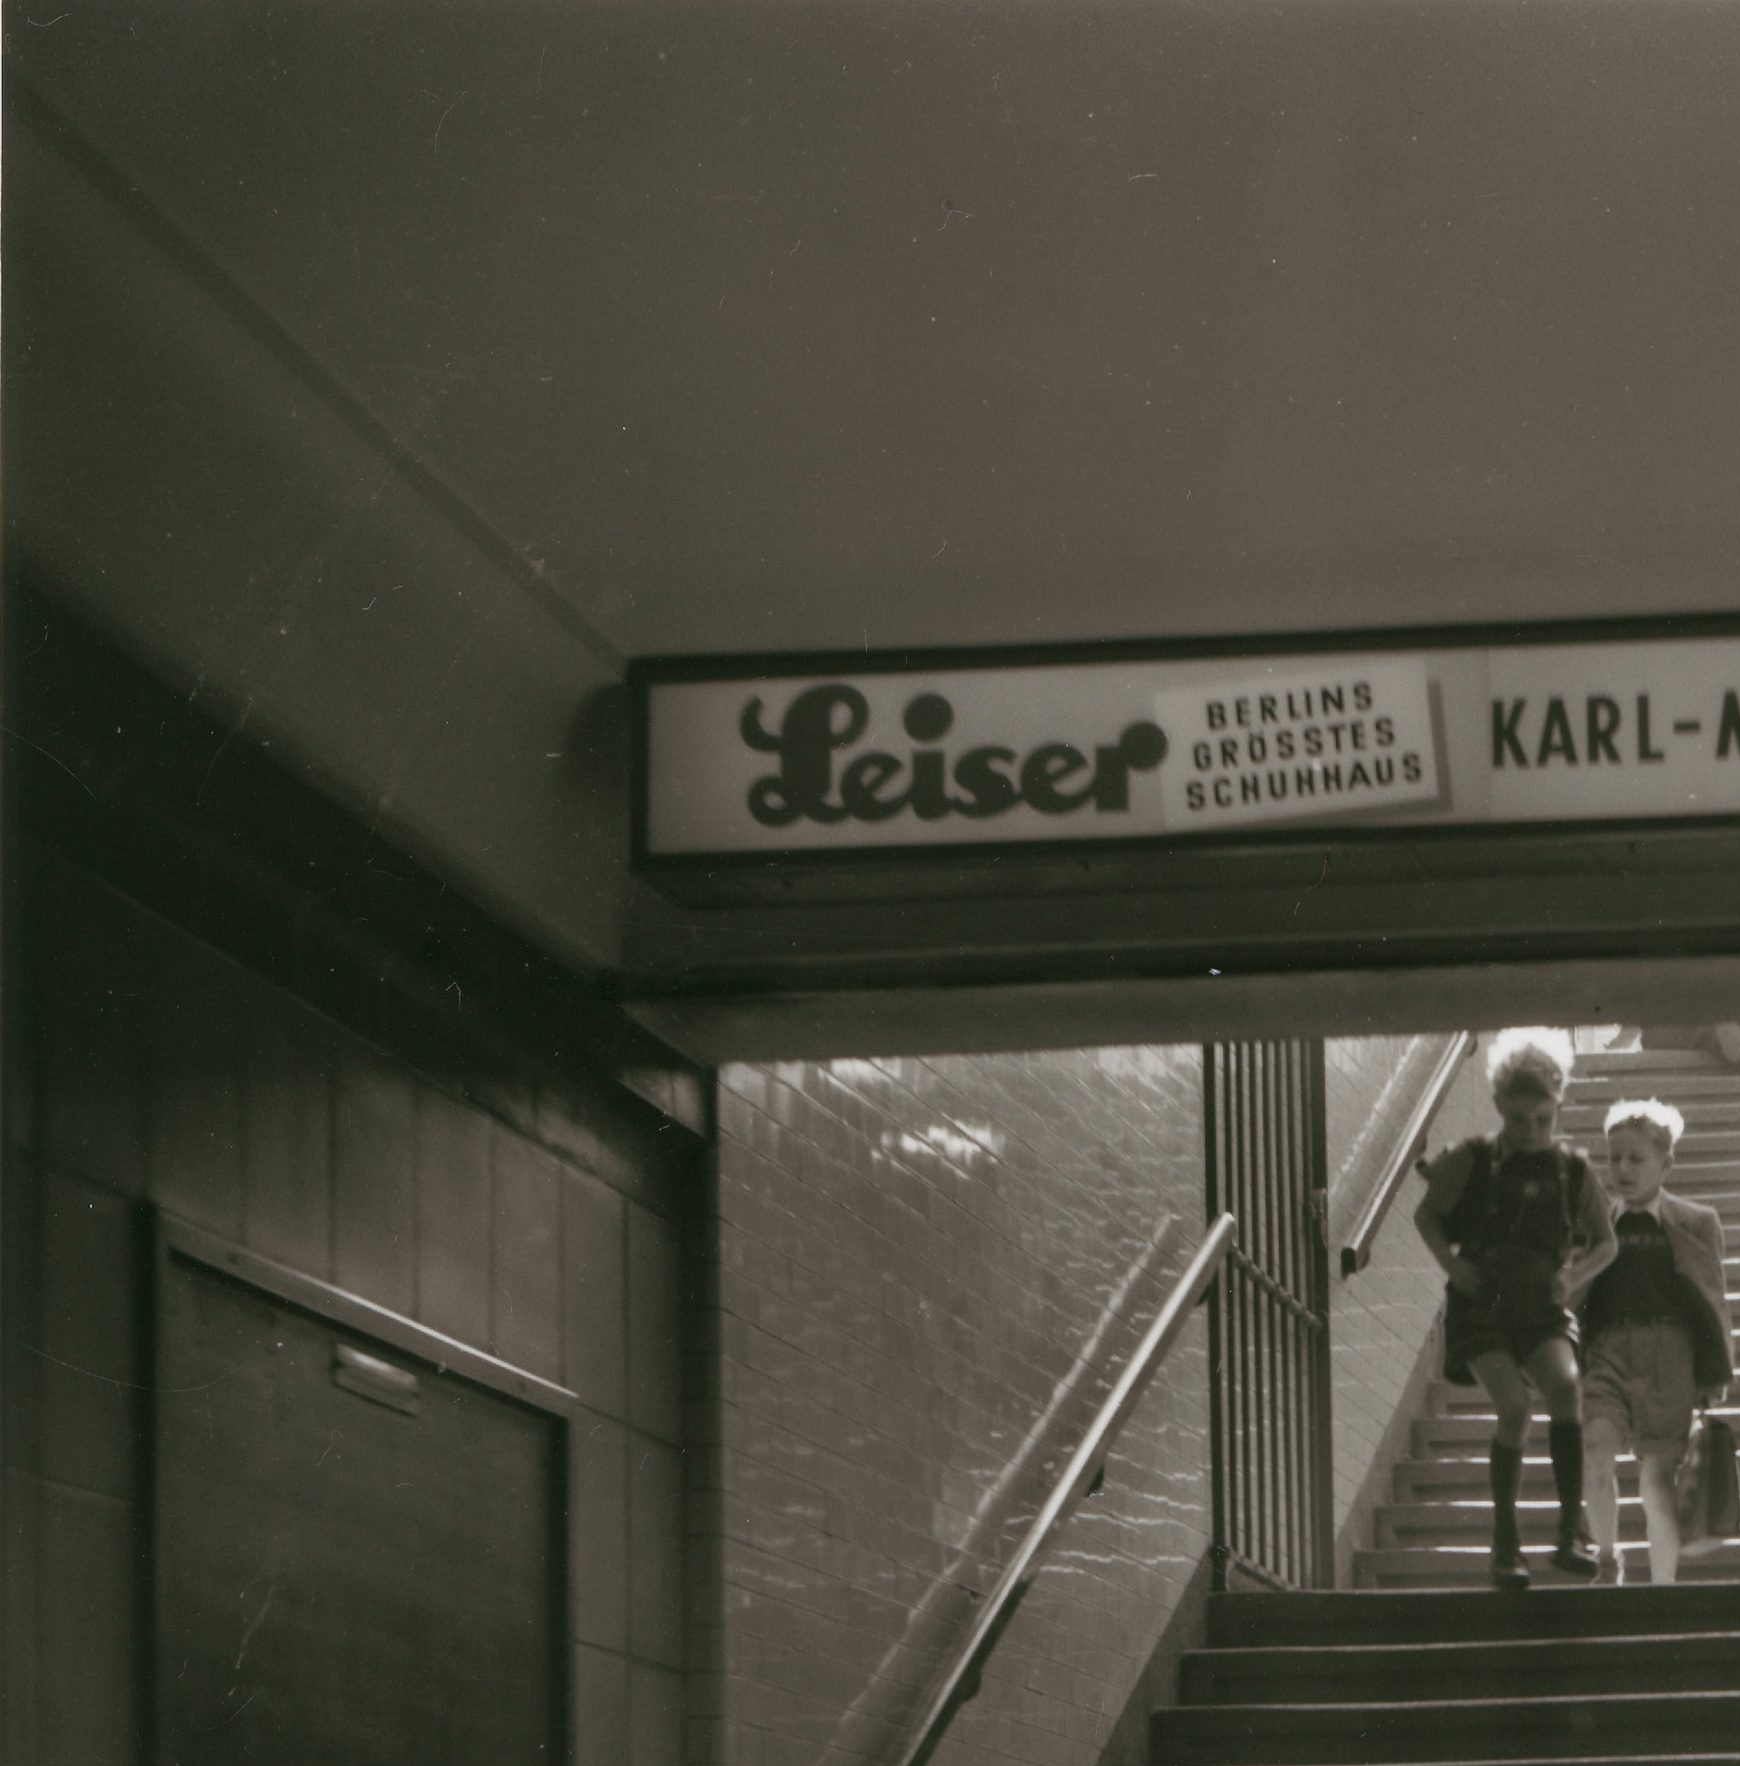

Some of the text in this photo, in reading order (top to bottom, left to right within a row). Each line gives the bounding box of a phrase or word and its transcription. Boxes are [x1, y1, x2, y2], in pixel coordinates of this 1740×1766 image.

[1206, 680, 1374, 732] BERLINS
[739, 684, 1168, 827] Leiser
[1192, 716, 1396, 771] GRÖSSTES
[1186, 753, 1422, 812] SCHUHHAUS
